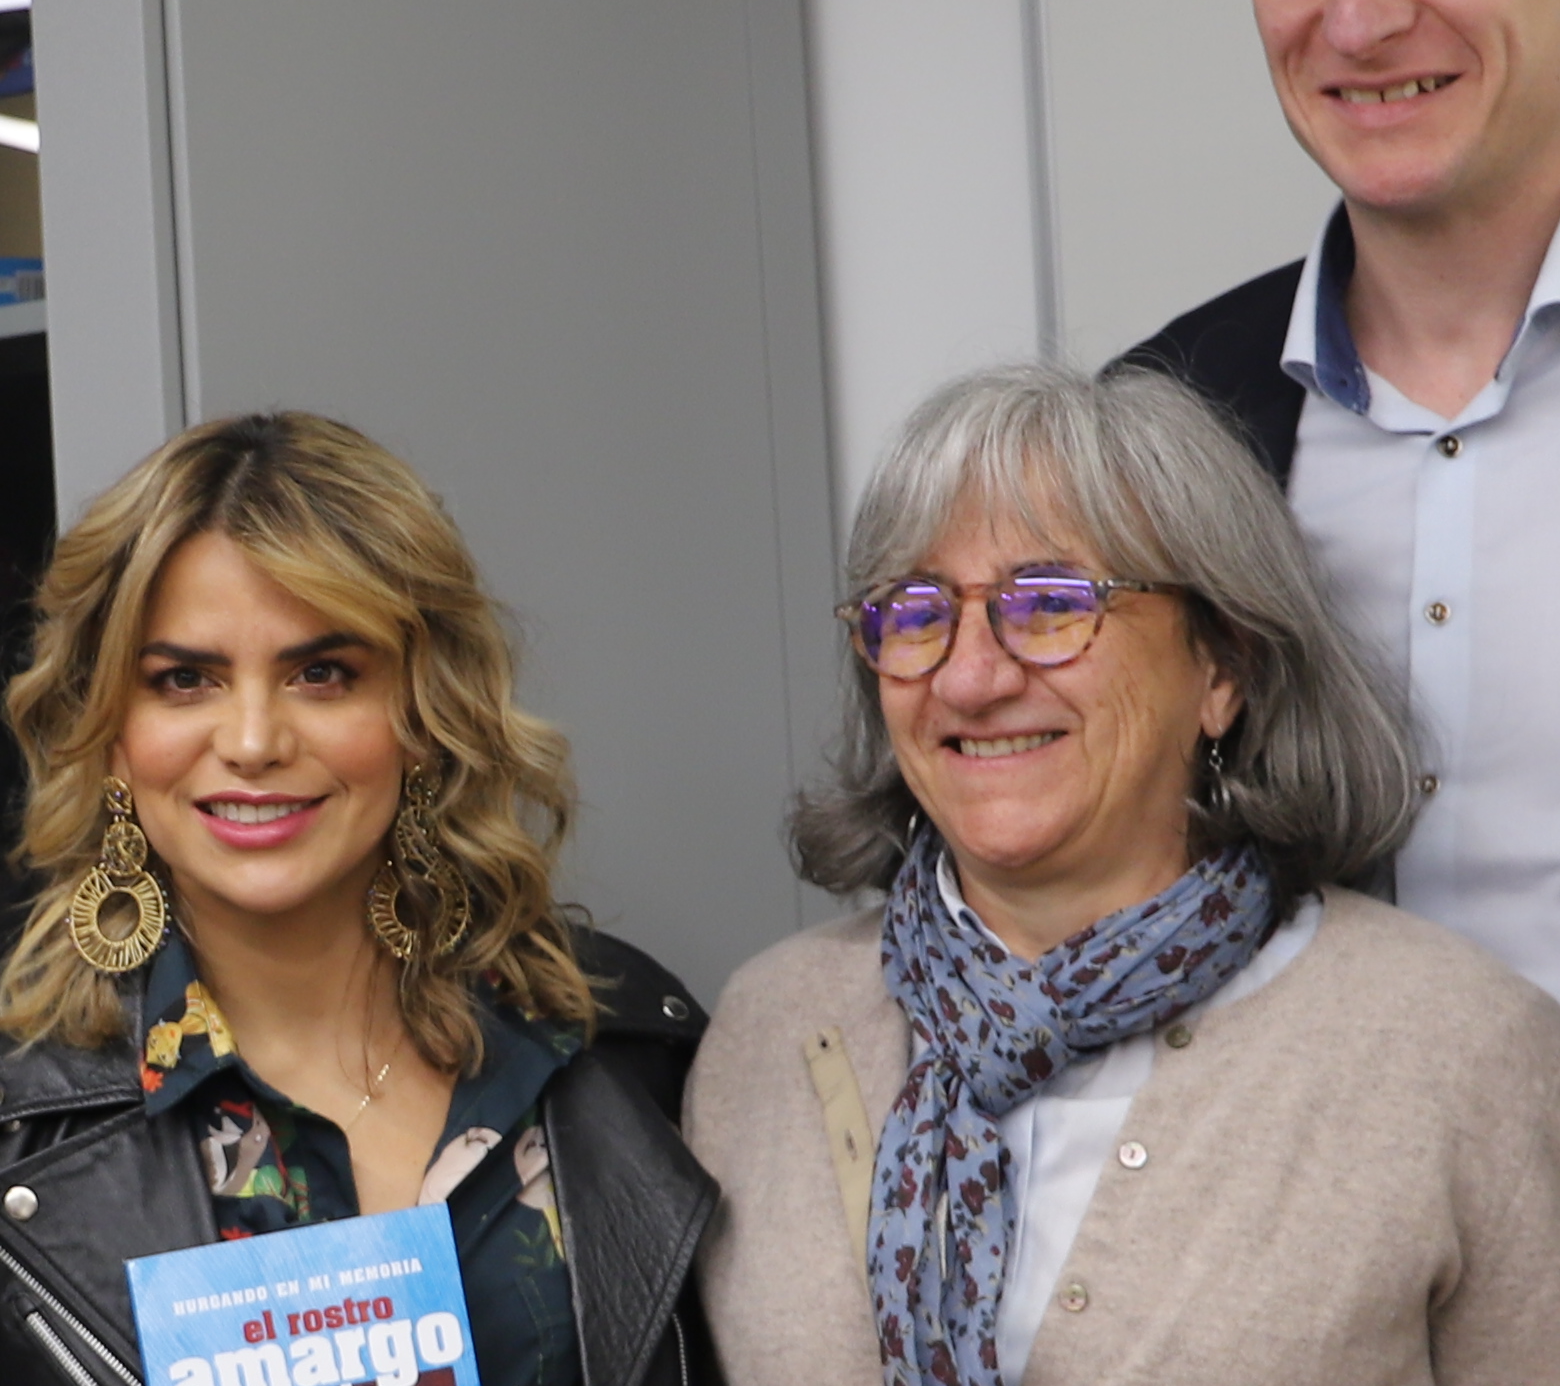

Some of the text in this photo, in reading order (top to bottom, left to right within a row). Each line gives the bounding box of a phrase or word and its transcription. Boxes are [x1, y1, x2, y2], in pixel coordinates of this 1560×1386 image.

[276, 1280, 300, 1298] EN
[308, 1274, 330, 1292] MI
[339, 1257, 423, 1286] MEMORIA
[243, 1296, 394, 1343] el rostro
